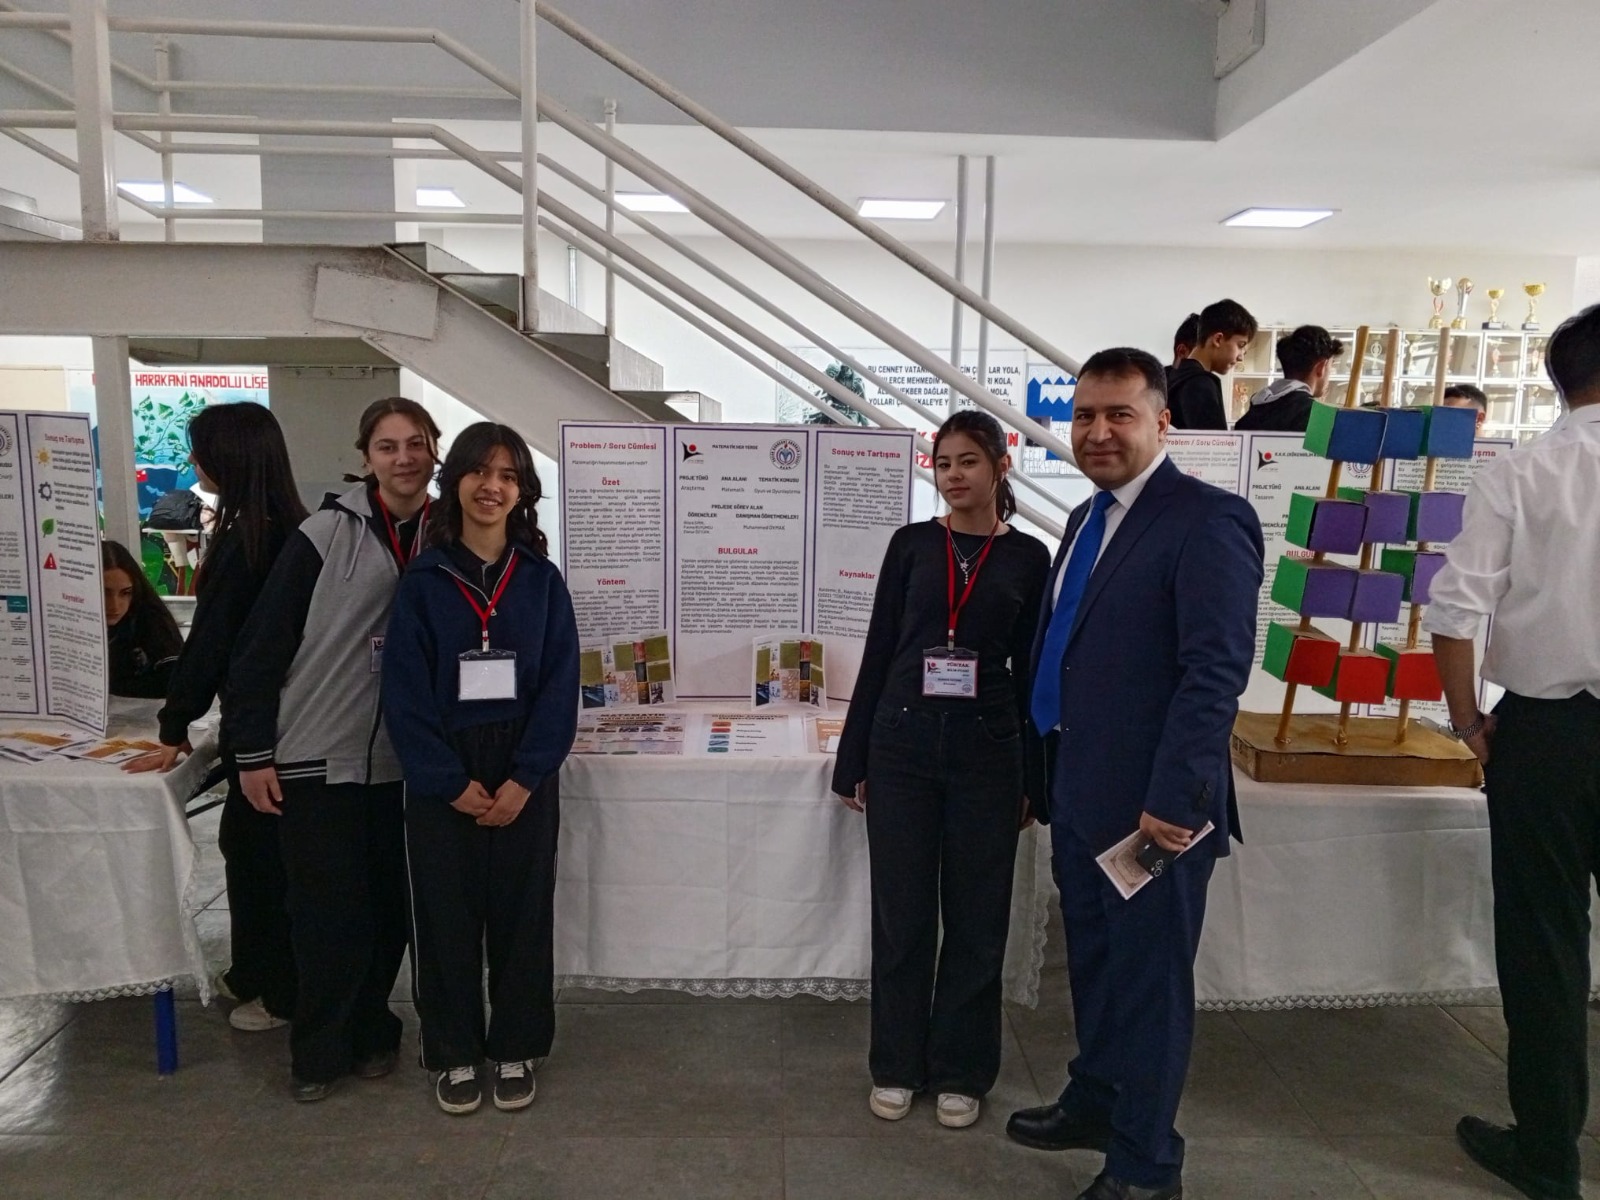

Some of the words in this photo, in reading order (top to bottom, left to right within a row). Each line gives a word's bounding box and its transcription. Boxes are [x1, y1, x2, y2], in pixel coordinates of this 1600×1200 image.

[1002, 367, 1020, 375] YOLA,
[136, 372, 188, 387] HARAKANİ
[190, 375, 242, 388] ANADOLU
[244, 374, 268, 389] LİSE
[924, 386, 948, 394] DAĞLAR
[832, 448, 854, 457] Sonuç
[867, 450, 900, 458] Tartışma
[602, 476, 620, 486] Özet
[839, 569, 876, 579] Kaynaklar
